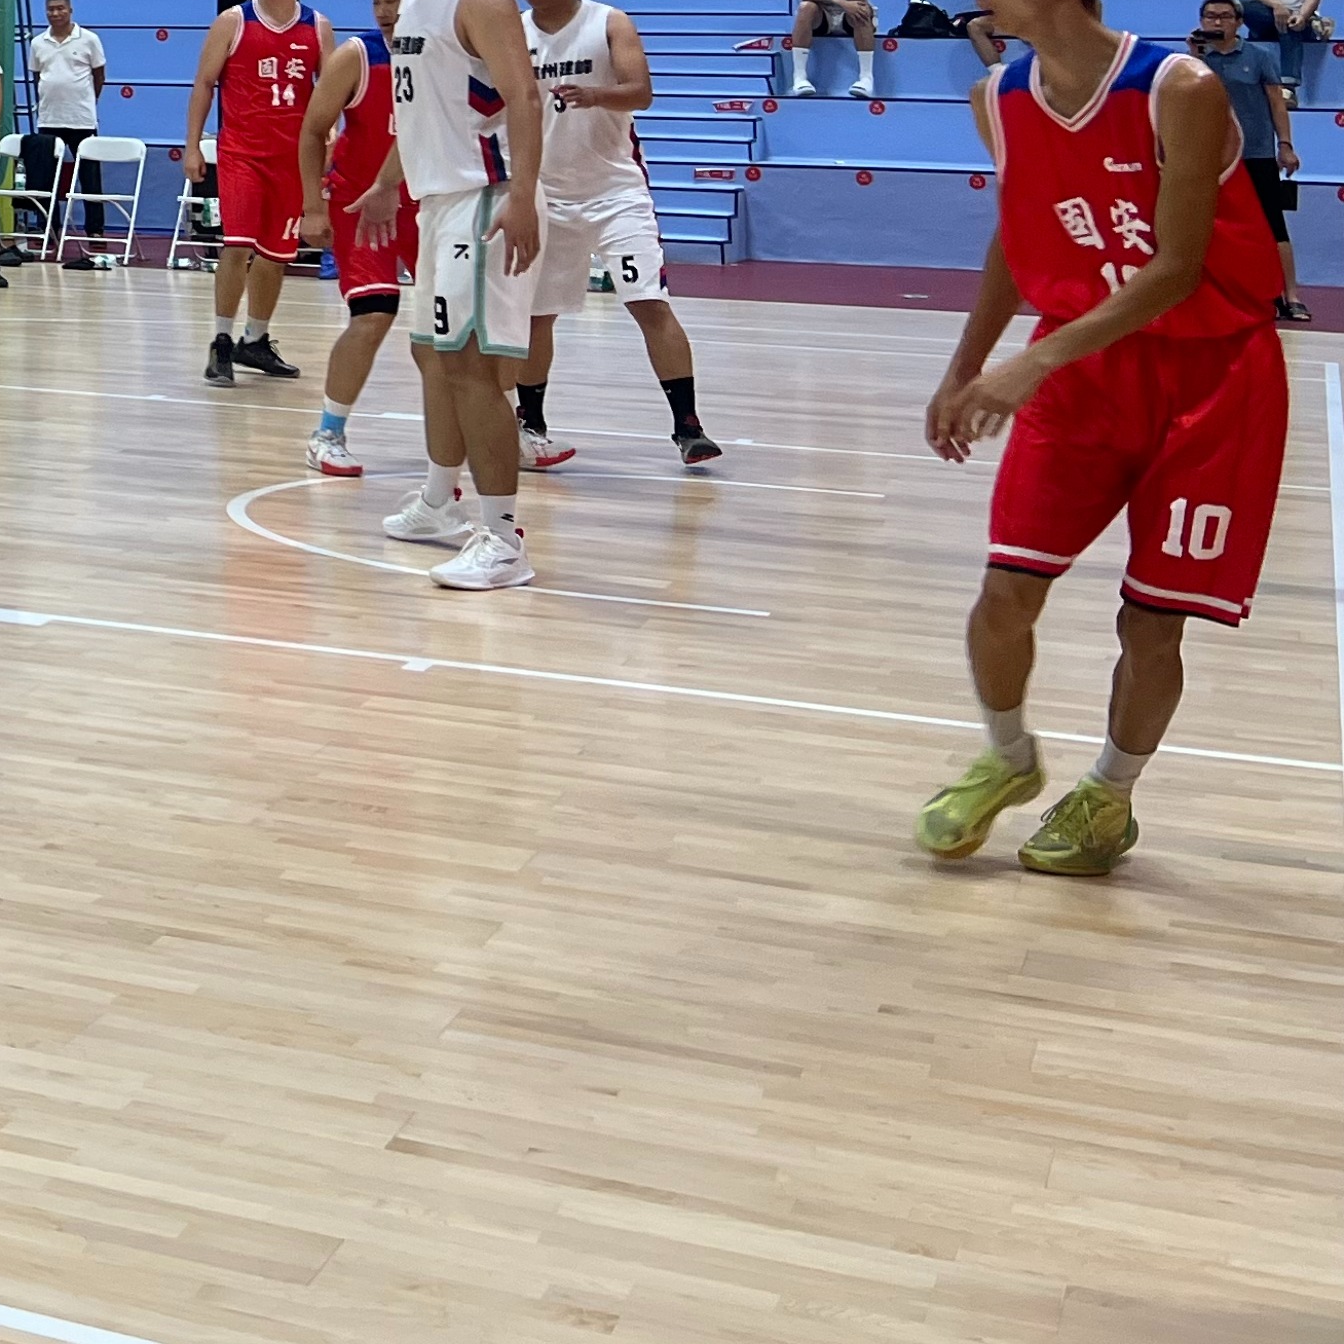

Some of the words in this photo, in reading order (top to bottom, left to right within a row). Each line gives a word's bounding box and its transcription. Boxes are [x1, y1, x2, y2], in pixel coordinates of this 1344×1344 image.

[271, 83, 296, 107] 14
[394, 65, 414, 104] 23
[282, 216, 301, 240] 14
[621, 255, 639, 283] 5
[1162, 497, 1233, 561] 10
